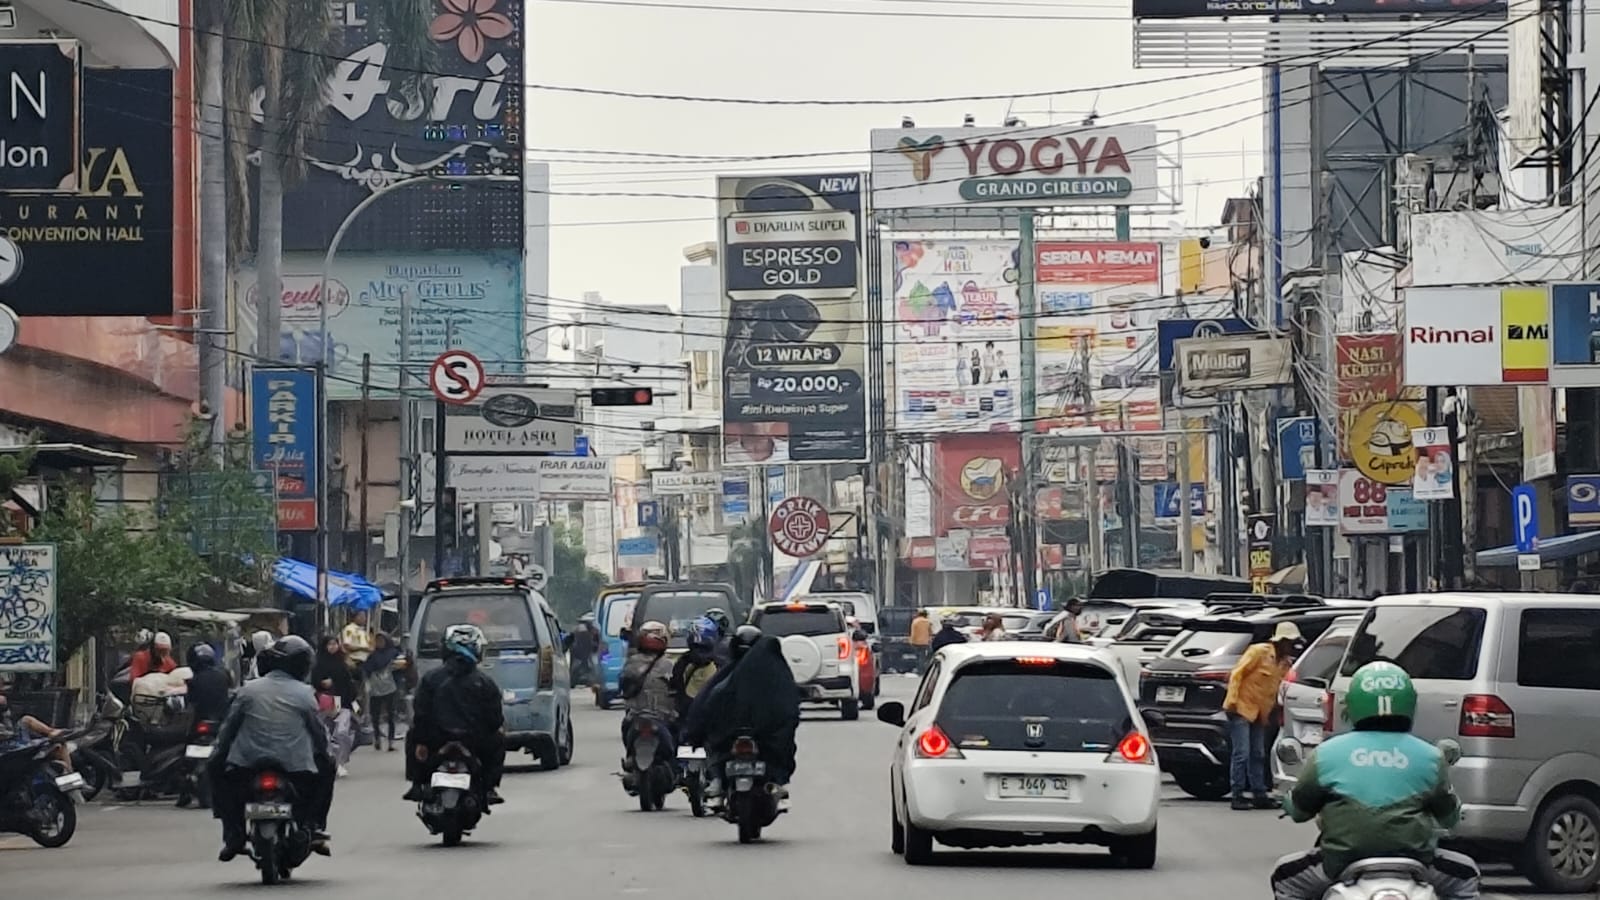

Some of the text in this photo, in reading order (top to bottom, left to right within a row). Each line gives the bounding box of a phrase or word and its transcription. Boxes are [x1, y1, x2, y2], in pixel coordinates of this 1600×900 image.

[957, 136, 1132, 176] YOGYA
[819, 176, 858, 192] NEW
[975, 180, 1119, 195] GRAND CIREBON
[105, 226, 144, 241] HALL
[753, 219, 847, 233] DJARUM SUPER
[742, 246, 842, 266] ESPRESSO
[1040, 250, 1155, 265] SERBA HEMAT
[763, 268, 822, 285] GOLD
[1410, 325, 1494, 345] Rinnai
[756, 347, 833, 361] 12 WRAPS
[1349, 347, 1384, 361] NASI
[773, 375, 851, 392] 20.000,-
[1348, 389, 1388, 402] AYAM
[268, 380, 297, 444] PARKIR
[464, 430, 515, 442] HOTEL
[1354, 477, 1387, 503] 88
[642, 505, 653, 523] P
[777, 500, 820, 518] OPTIK
[1518, 494, 1532, 543] P
[1038, 592, 1046, 610] P
[1361, 674, 1406, 692] Grab
[1350, 747, 1409, 769] Grab
[1002, 778, 1009, 790] E
